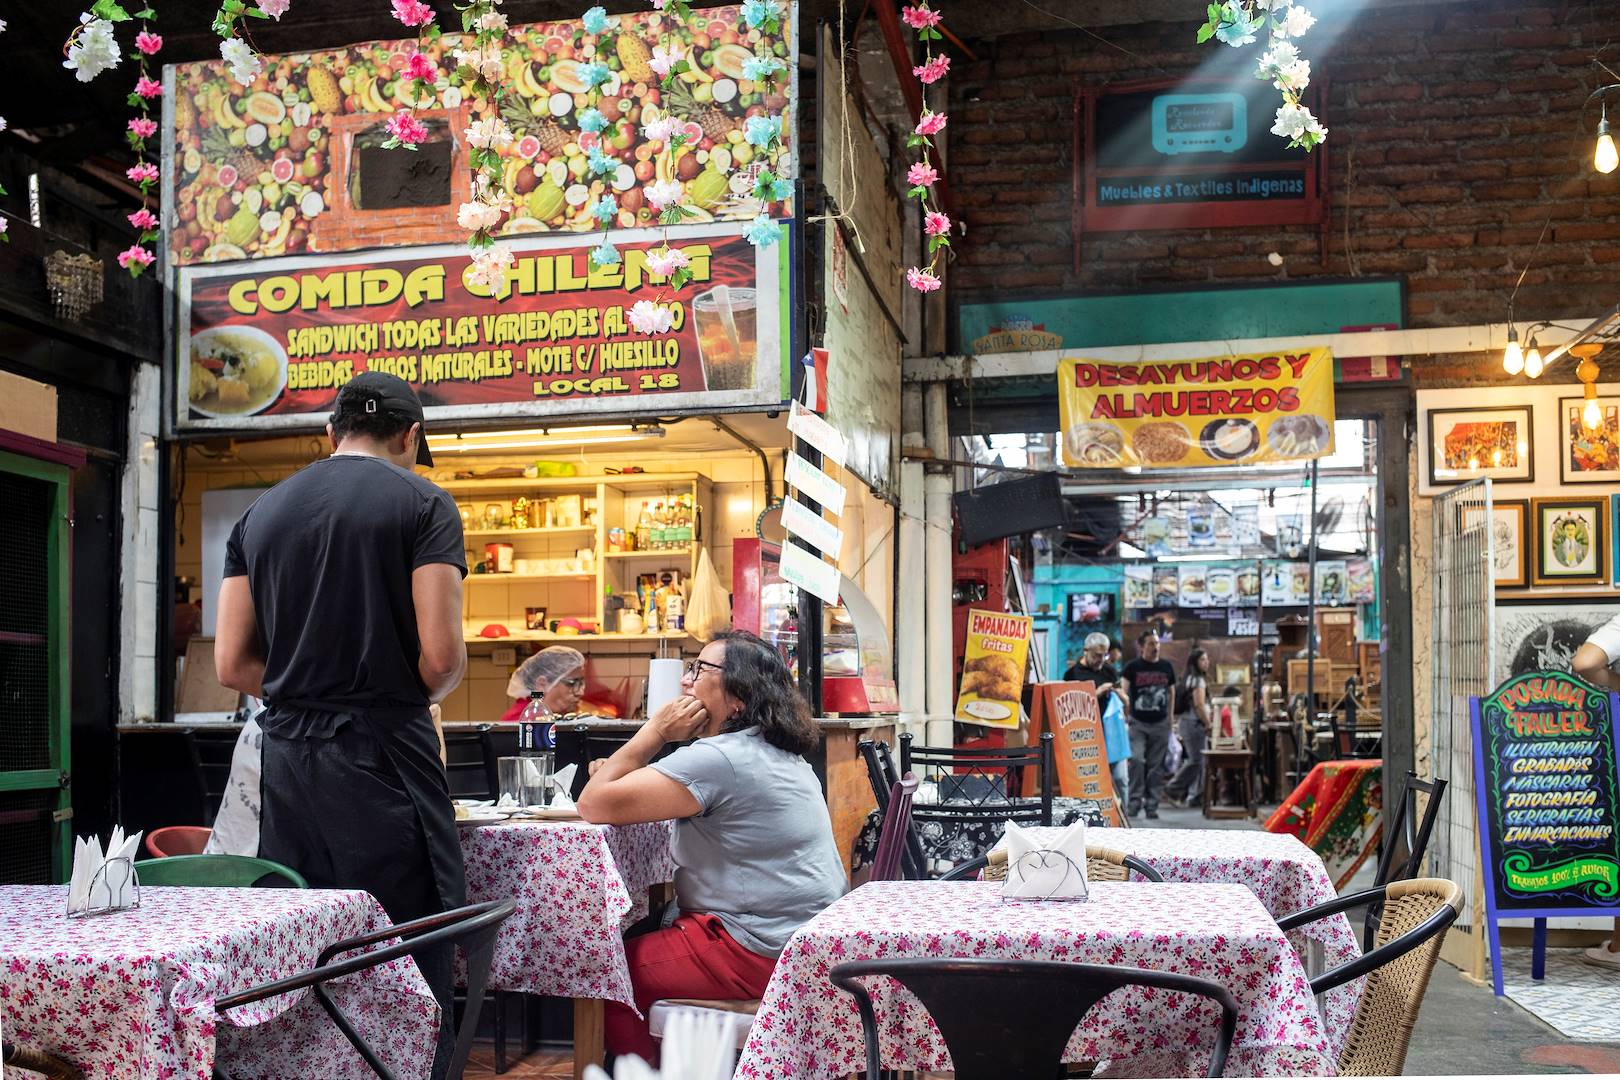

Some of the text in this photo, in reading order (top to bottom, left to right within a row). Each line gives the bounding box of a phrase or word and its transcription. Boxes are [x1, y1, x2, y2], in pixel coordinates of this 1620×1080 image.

[1101, 184, 1161, 200] Muebles
[1164, 184, 1173, 196] &
[1176, 181, 1232, 196] Textiles
[228, 264, 446, 315] COMIDA
[287, 323, 378, 357] SANDWICH
[382, 318, 441, 350] TODAS
[446, 316, 479, 348] LAS
[483, 307, 599, 346] VARIEDADES
[603, 306, 628, 338] AL
[287, 360, 353, 389] BEBIDAS
[421, 349, 512, 384] NATURALES
[527, 345, 572, 375] MOTE
[576, 344, 596, 371] C/
[600, 339, 680, 373] HUESILLO
[1075, 353, 1311, 387] DESAYUNOS Y
[533, 373, 680, 395] LOCAL 18
[1091, 387, 1301, 418] ALMUERZOS
[972, 615, 1028, 640] EMPANADAS
[1498, 678, 1586, 711] POSADA
[1507, 711, 1594, 736] TALLER
[1512, 756, 1592, 773] GRABADOS
[1503, 774, 1593, 791] MÁSCARAS
[1505, 789, 1597, 808] FOTOGRAFÍA
[1506, 806, 1605, 826] SERIGRAFÍAS
[1503, 825, 1612, 843] ENMARCACIONES
